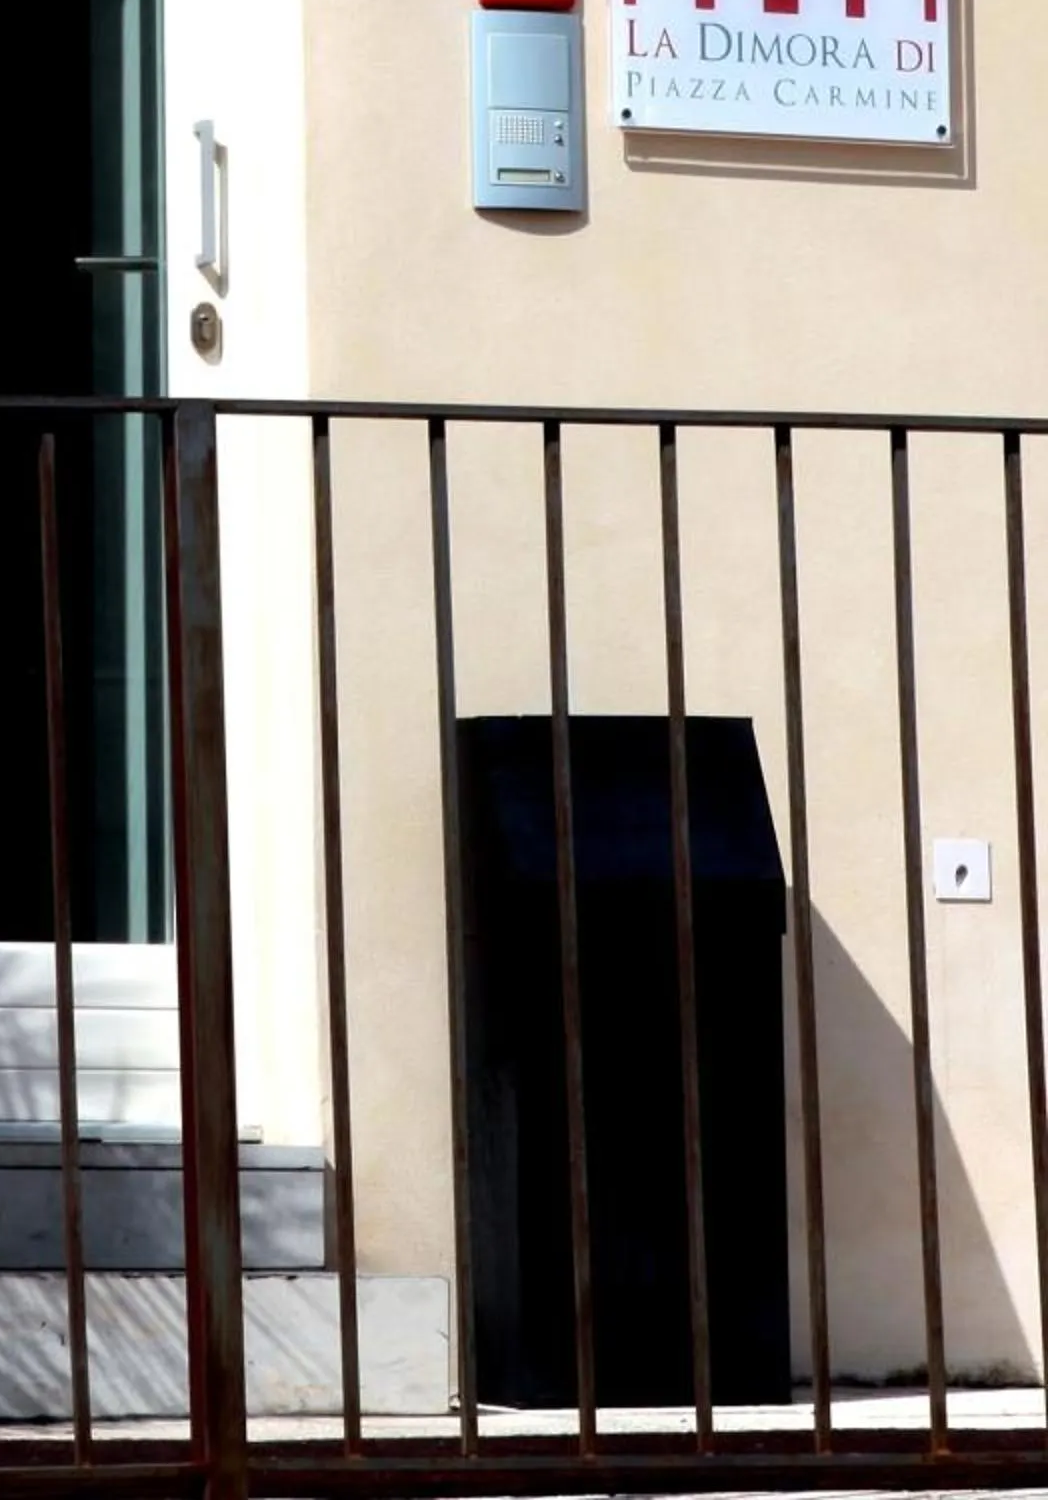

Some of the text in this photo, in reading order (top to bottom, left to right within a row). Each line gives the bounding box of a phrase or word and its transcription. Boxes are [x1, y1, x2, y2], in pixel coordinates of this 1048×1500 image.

[627, 19, 935, 73] LA DIMORA DI
[627, 71, 937, 111] PIAZZA CARMINE
